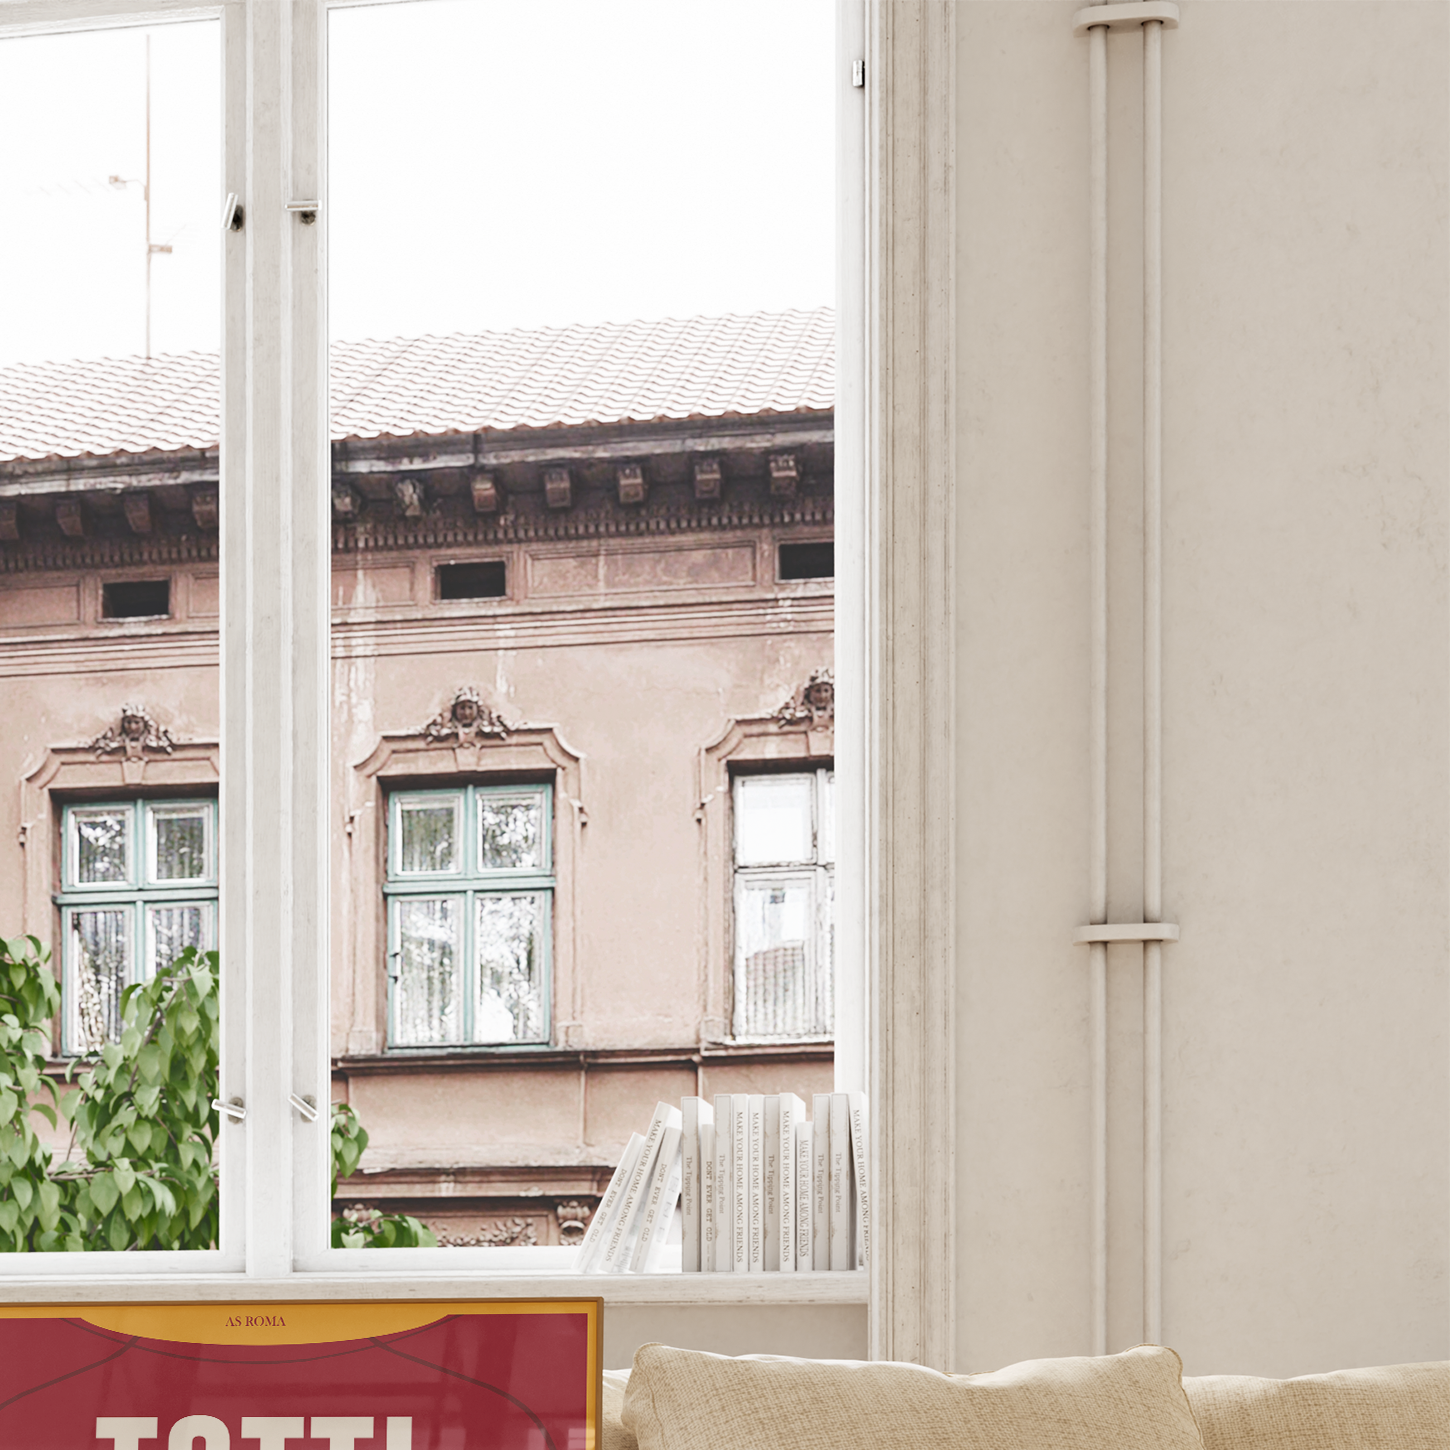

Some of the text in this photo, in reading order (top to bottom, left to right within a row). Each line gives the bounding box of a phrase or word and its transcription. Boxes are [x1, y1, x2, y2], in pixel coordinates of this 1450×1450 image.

[589, 1169, 627, 1243] DONT EVER GET OLD
[606, 1120, 661, 1262] MAKE YOUR HOME AMONG FRIENDS
[641, 1163, 667, 1242] DONT EVER GET OLD
[226, 1315, 286, 1328] AS ROMA
